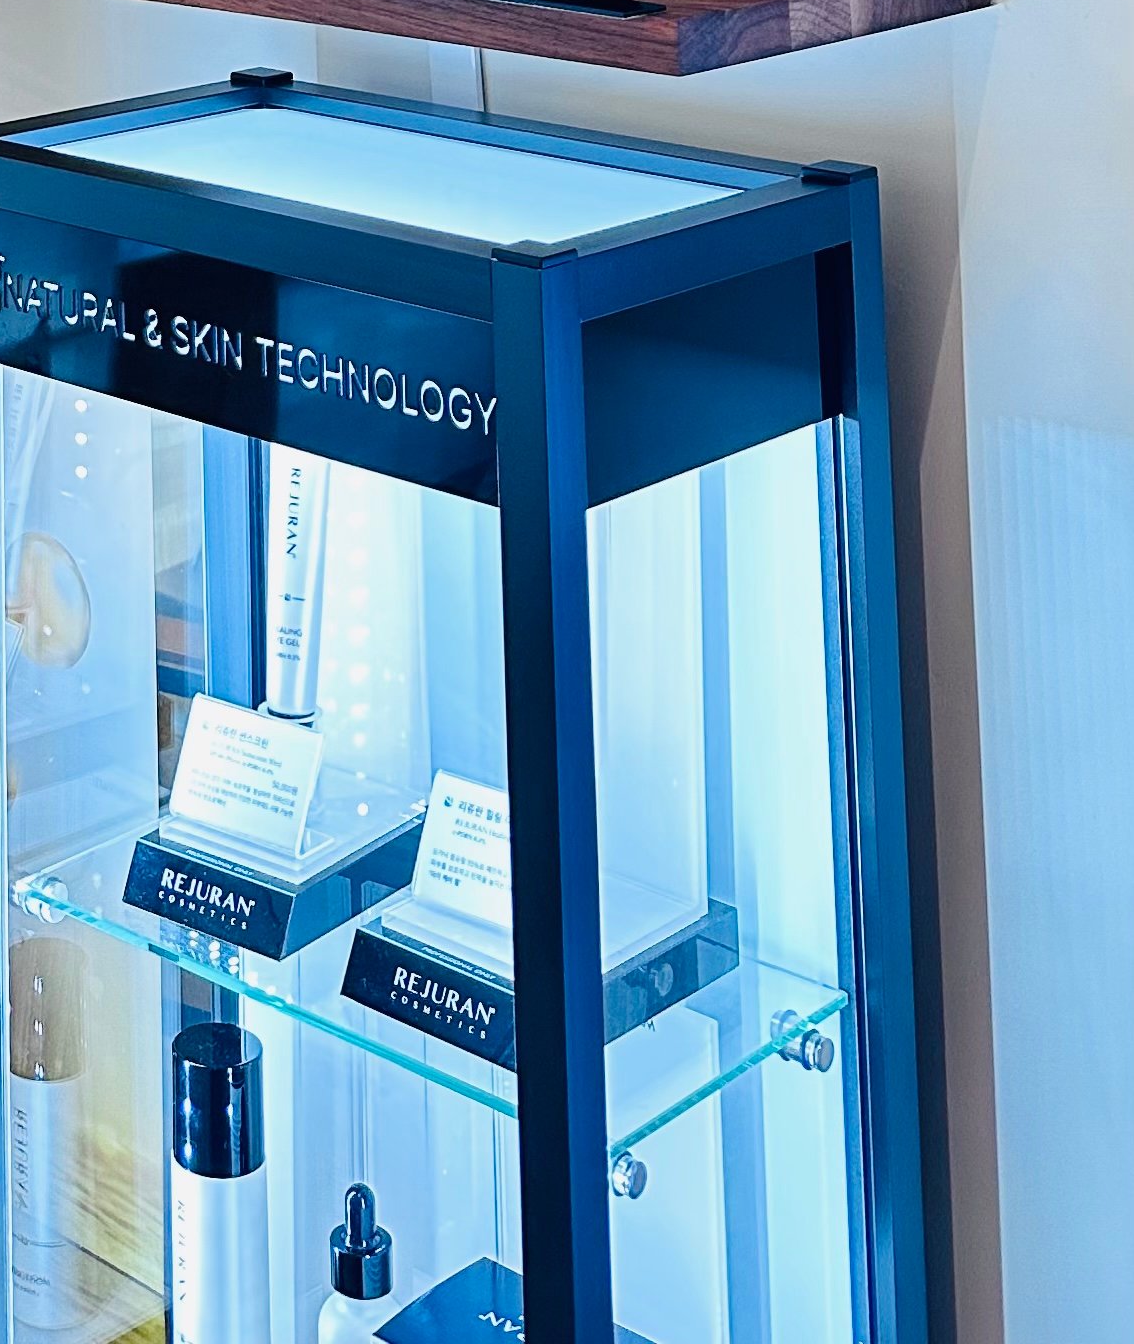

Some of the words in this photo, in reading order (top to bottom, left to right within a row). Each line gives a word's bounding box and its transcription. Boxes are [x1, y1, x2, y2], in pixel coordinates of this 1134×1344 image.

[4, 274, 136, 342] NATURAL
[143, 307, 163, 349] &
[171, 316, 243, 370] SKIN
[255, 336, 498, 435] TECHNOLOGY
[286, 467, 302, 559] REJURAN
[458, 800, 484, 817] 리쥬란
[158, 890, 248, 931] COSMETICS
[160, 867, 256, 917] REJURAN
[390, 990, 487, 1040] COSMETICS
[393, 966, 496, 1025] REJURAN
